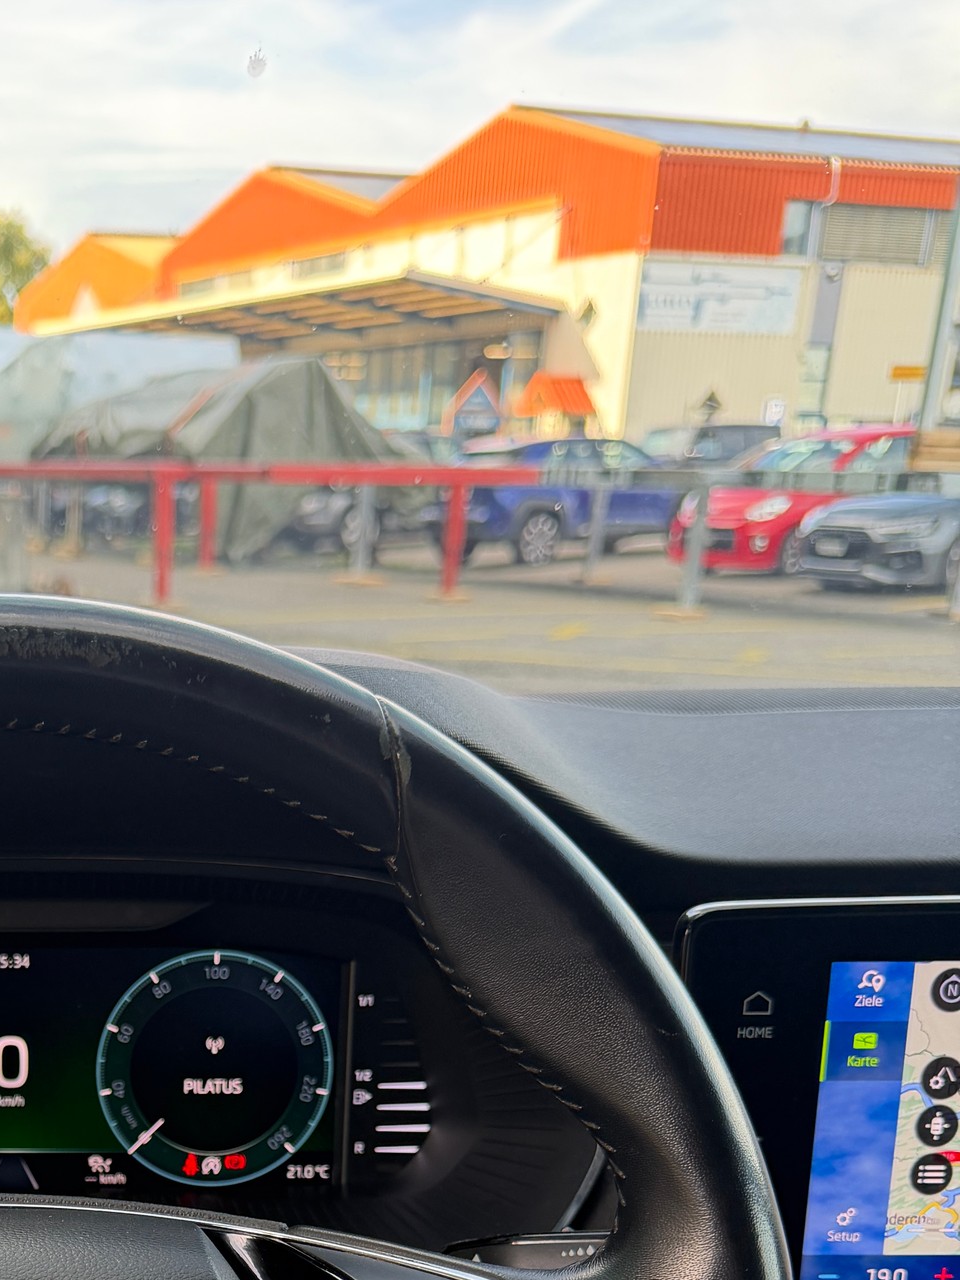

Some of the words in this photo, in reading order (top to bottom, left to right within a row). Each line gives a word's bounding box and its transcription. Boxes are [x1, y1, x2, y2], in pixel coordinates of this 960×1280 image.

[203, 966, 230, 980] 100
[152, 981, 172, 1000] 80
[259, 977, 284, 1001] 140
[854, 994, 884, 1008] Ziele
[117, 1024, 134, 1044] 60
[296, 1020, 315, 1046] 180
[737, 1026, 774, 1039] HOME
[847, 1055, 879, 1067] Karte
[355, 1068, 373, 1082] 1/2
[183, 1078, 244, 1095] PILATUS
[299, 1075, 317, 1103] 220
[267, 1124, 293, 1151] 260
[353, 1141, 366, 1155] R
[827, 1230, 861, 1243] Setup
